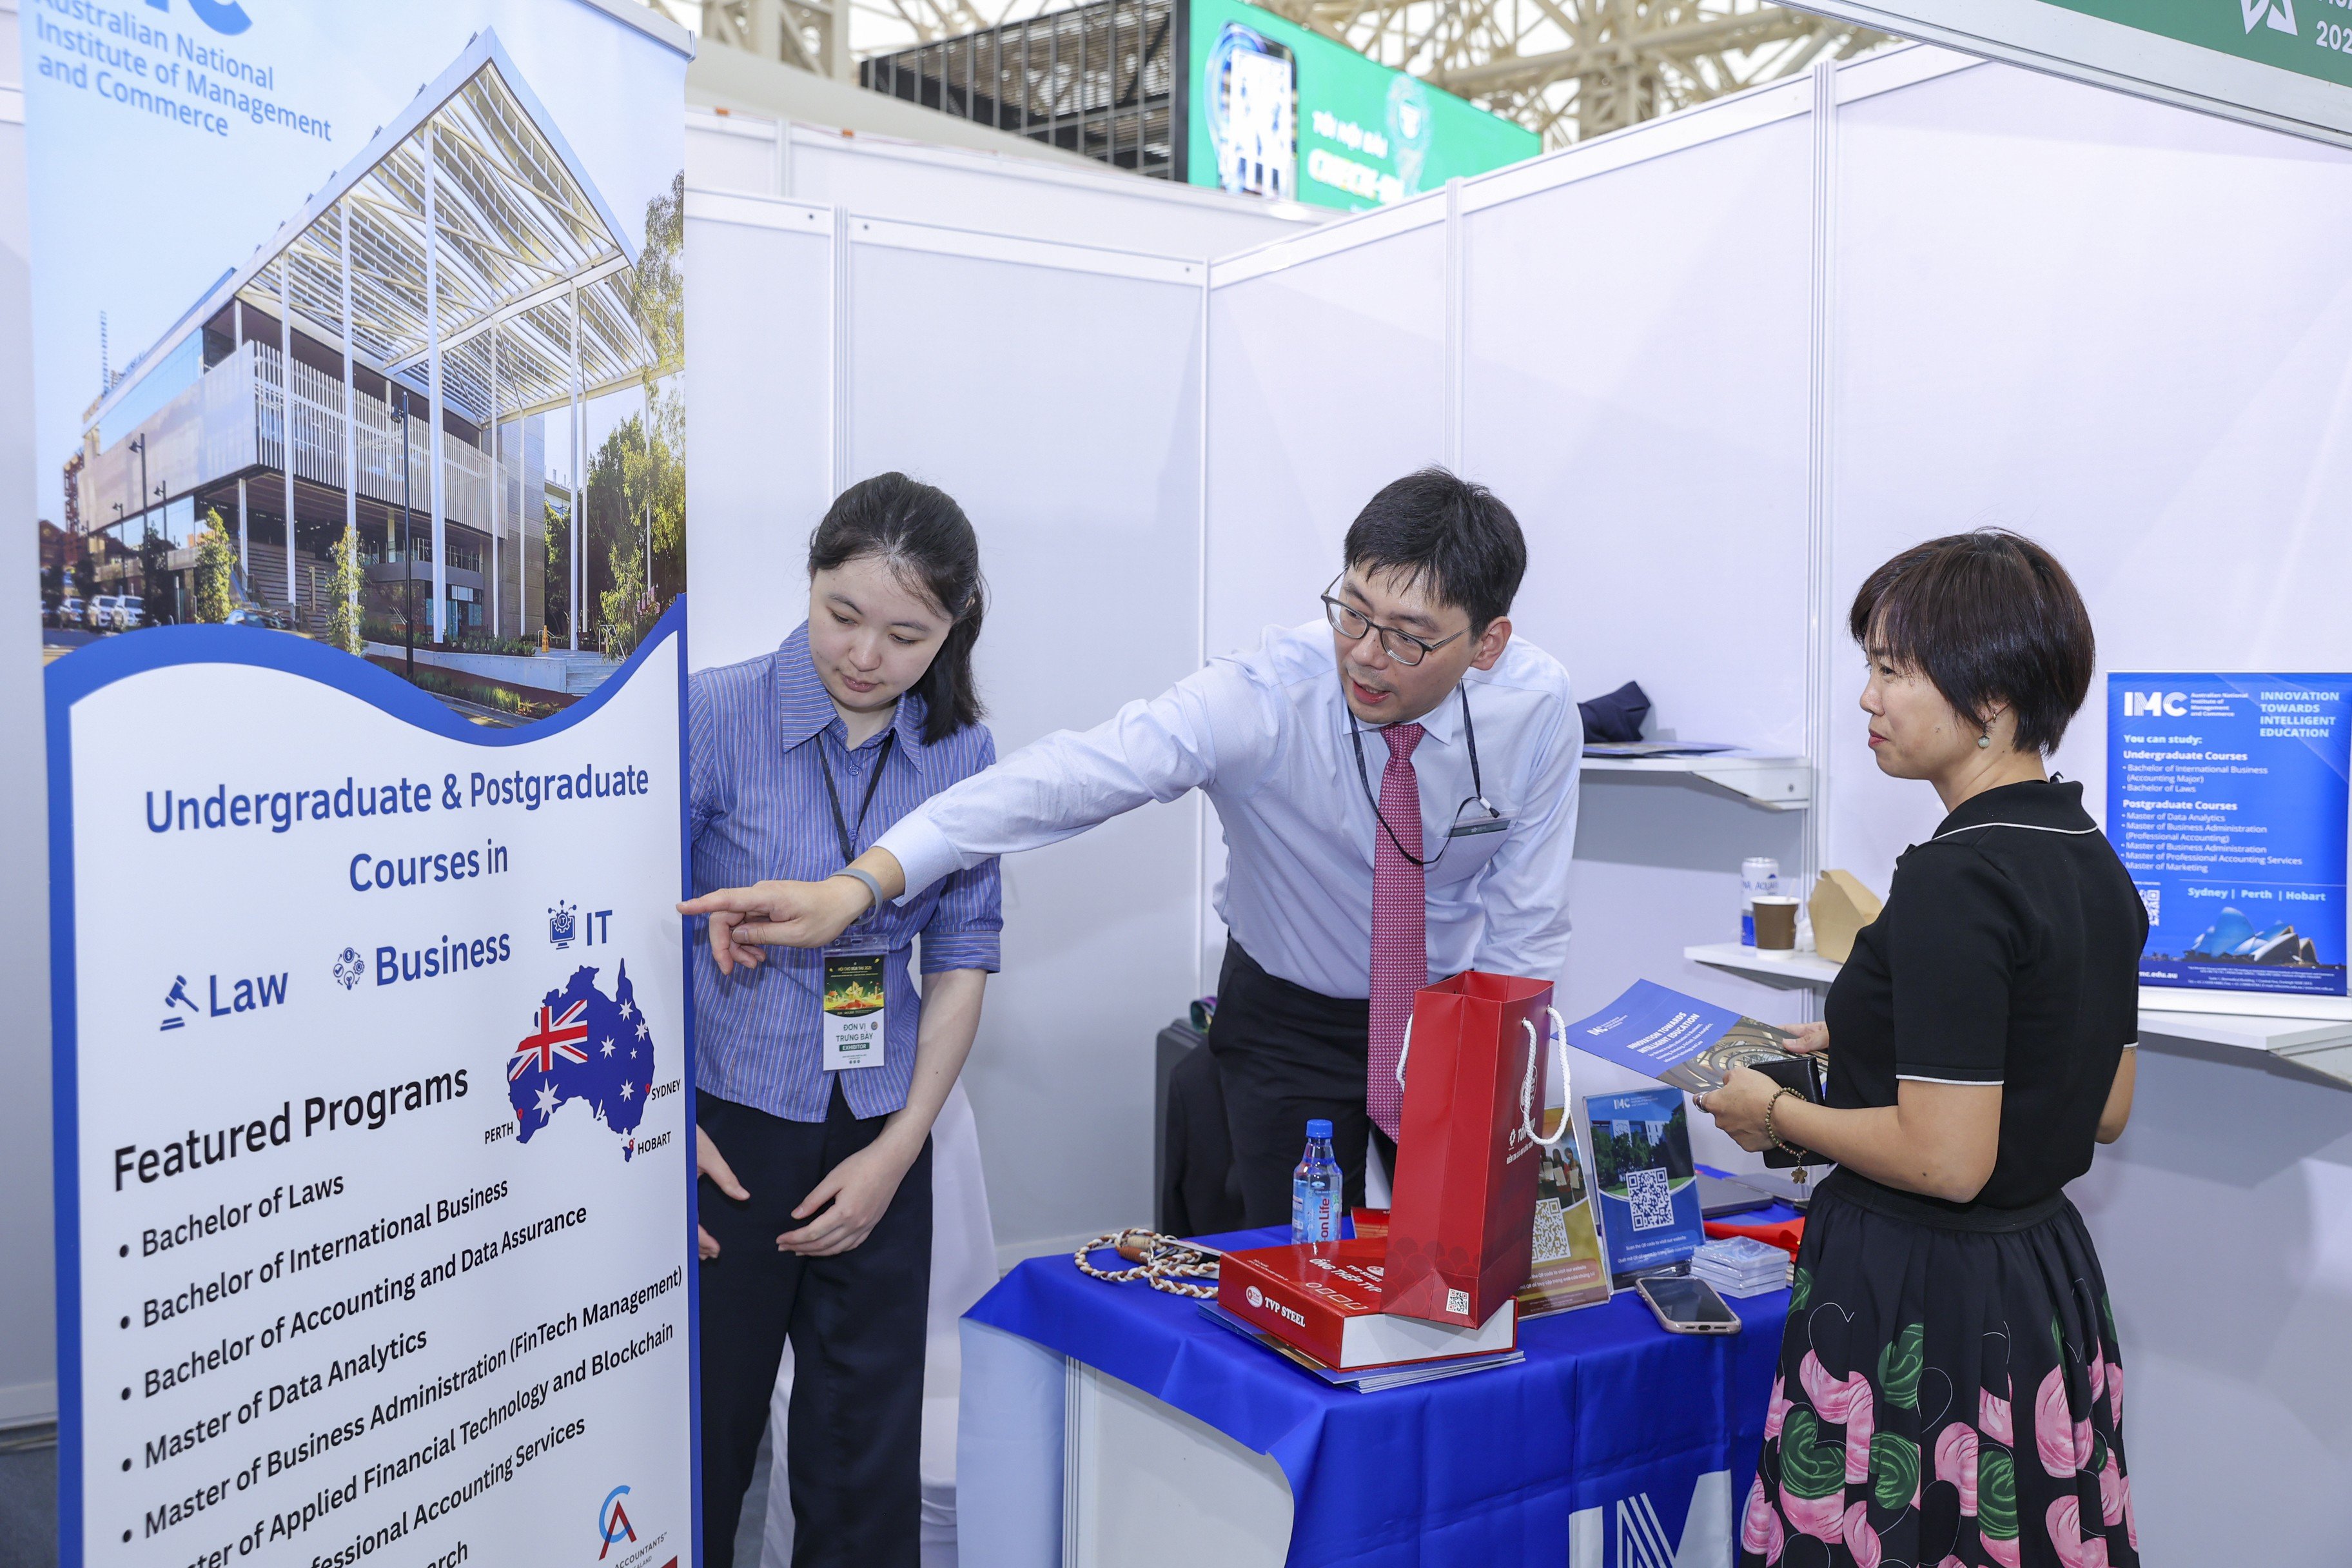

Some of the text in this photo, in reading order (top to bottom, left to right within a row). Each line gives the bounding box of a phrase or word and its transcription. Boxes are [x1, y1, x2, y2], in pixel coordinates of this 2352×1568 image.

[38, 0, 169, 52] ustralian
[176, 33, 274, 91] National
[36, 14, 148, 77] Institute
[155, 63, 180, 88] of
[187, 69, 333, 142] Management
[39, 54, 229, 137] and Commerce
[2124, 691, 2188, 717] IMC
[2260, 691, 2340, 701] INNOVATION
[2260, 703, 2320, 713] TOWARDS
[2260, 716, 2337, 725] INTELLIGENT
[2123, 734, 2203, 746] You can study:
[2259, 727, 2329, 738] EDUCATION
[2122, 750, 2248, 762] Undergraduate Courses
[2126, 774, 2205, 784] (Accounting Major)
[2127, 763, 2163, 772] Bachelor
[2175, 765, 2230, 774] International
[2230, 766, 2269, 774] Business
[146, 763, 649, 834] Undergraduate & Postgraduate
[2127, 783, 2197, 793] Bachelor of Laws
[2122, 799, 2238, 811] Postgraduate Courses
[2126, 812, 2226, 823] Master of Data Analytics
[2126, 822, 2155, 830] Master
[2166, 823, 2204, 832] Business
[2204, 824, 2268, 834] Administration
[2125, 832, 2230, 844] (Professional Accounting)
[2126, 841, 2268, 854] Master of Business Administration
[349, 838, 509, 892] Courses in
[2125, 852, 2303, 866] Master of Professional Accounting Services
[2125, 861, 2208, 874] Master of Marketing
[2187, 887, 2326, 902] Sydney Perth Hobart
[586, 909, 613, 946] IT
[376, 932, 511, 987] Business
[209, 970, 289, 1018] Law
[1626, 1032, 1663, 1050] INNOVATION
[1658, 1012, 1687, 1034] TOWARDS
[1637, 1035, 1672, 1054] INTELLIGENT
[1667, 1013, 1701, 1039] EDUCATION
[651, 1079, 681, 1101] SYDNEY
[1613, 1098, 1631, 1110] IMC
[114, 1068, 469, 1192] Featured Programs
[484, 1121, 514, 1144] PERTH
[638, 1131, 672, 1155] HOBART
[142, 1175, 344, 1257] Bachelor of Laws
[1318, 1198, 1329, 1220] Life
[143, 1180, 508, 1328] Bachelor of International Business
[1358, 1282, 1382, 1293] TVP
[144, 1207, 587, 1398] Bachelor of Accounting and Data Assurance
[1264, 1296, 1280, 1313] TVP
[1280, 1306, 1306, 1328] STEEL
[145, 1330, 427, 1469] Master of Data Analytics
[145, 1265, 683, 1539] Master of Business Administration (FinTech Management)
[239, 1520, 264, 1556] of
[269, 1475, 357, 1542] Applied
[364, 1429, 456, 1494] Financial
[459, 1380, 549, 1445] Technology
[553, 1360, 585, 1393] and
[591, 1322, 673, 1377] Blockchain
[413, 1455, 513, 1530] Accounting
[516, 1418, 585, 1467] Services
